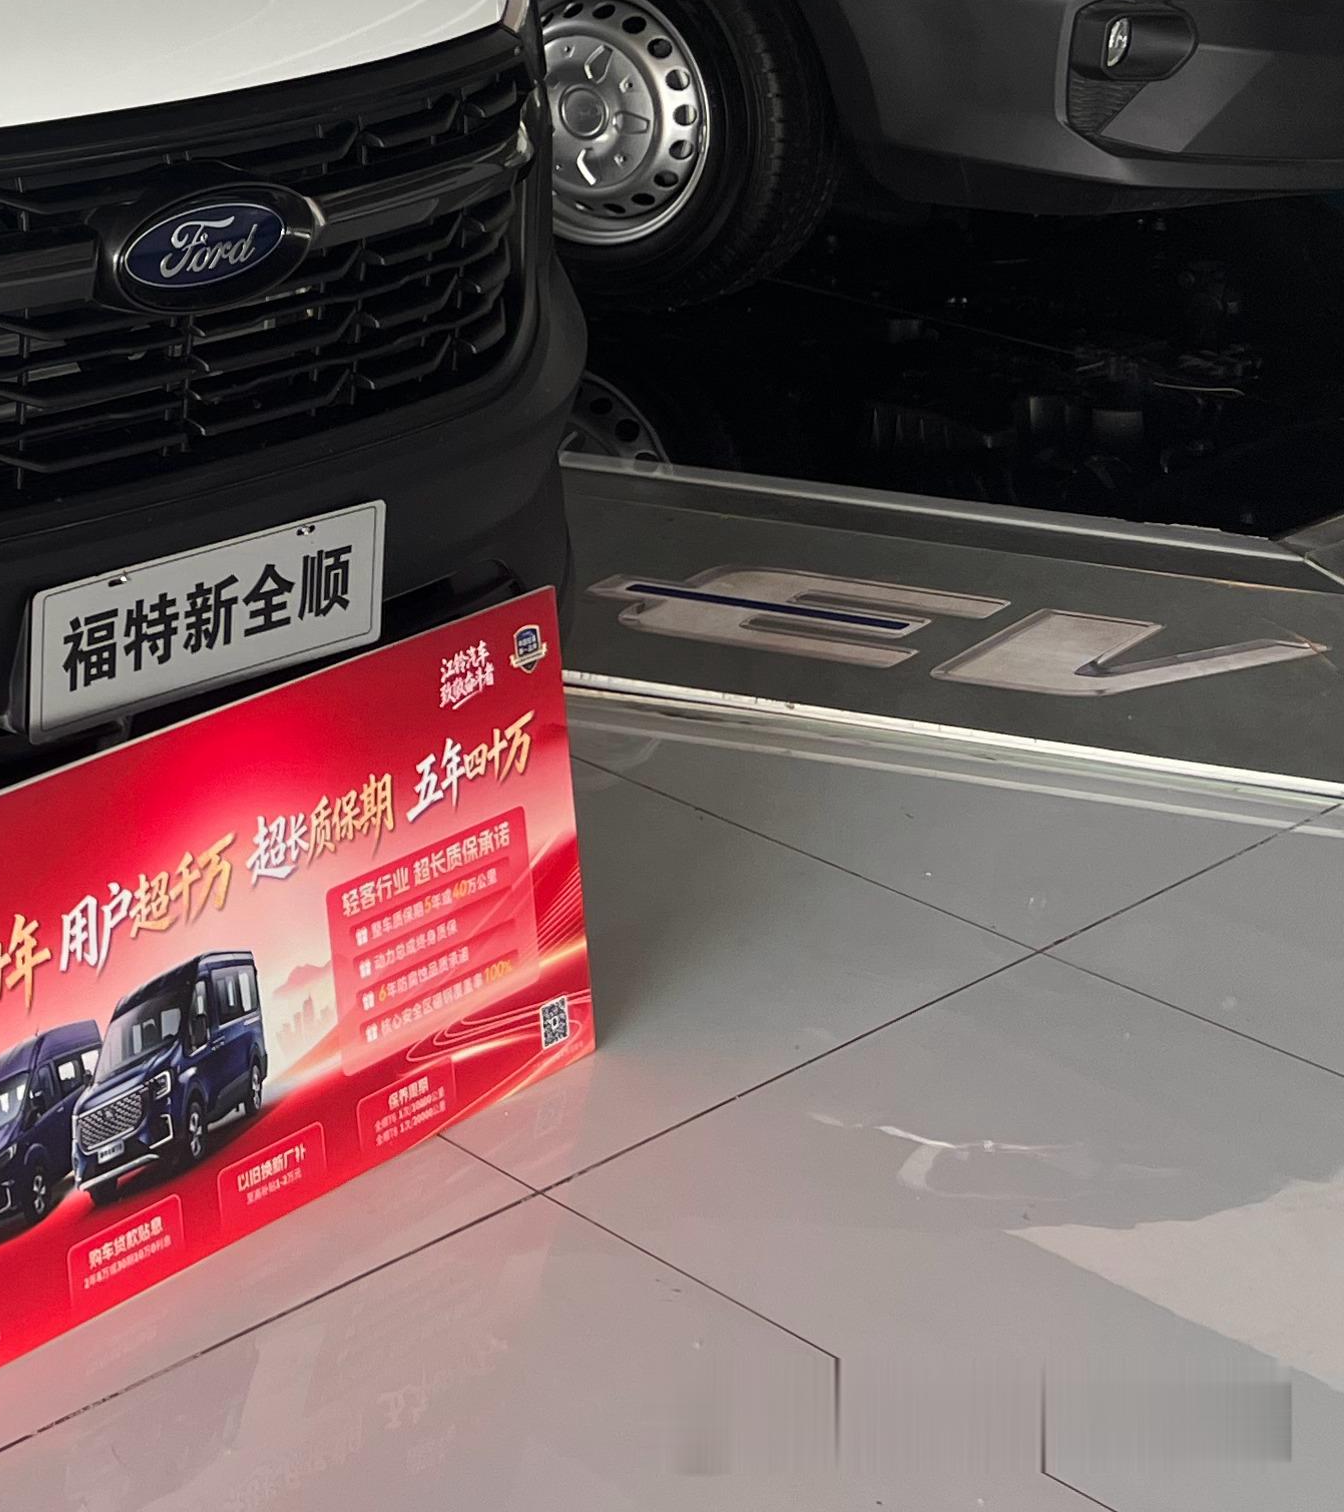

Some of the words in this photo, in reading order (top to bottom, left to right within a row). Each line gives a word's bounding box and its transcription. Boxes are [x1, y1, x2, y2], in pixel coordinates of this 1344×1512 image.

[160, 216, 258, 278] Ford
[62, 545, 353, 692] 福特新全顺
[58, 831, 239, 978] 用户超千万
[245, 772, 395, 885] 超长质保期
[406, 710, 536, 822] 五年四十万
[341, 866, 410, 918] 轻客行业
[413, 821, 511, 887] 超长质保承诺
[374, 918, 458, 970] 动力总成终身质保
[237, 1143, 307, 1193] 以旧换新厂补
[88, 1216, 164, 1270] 购车贷款贴息
